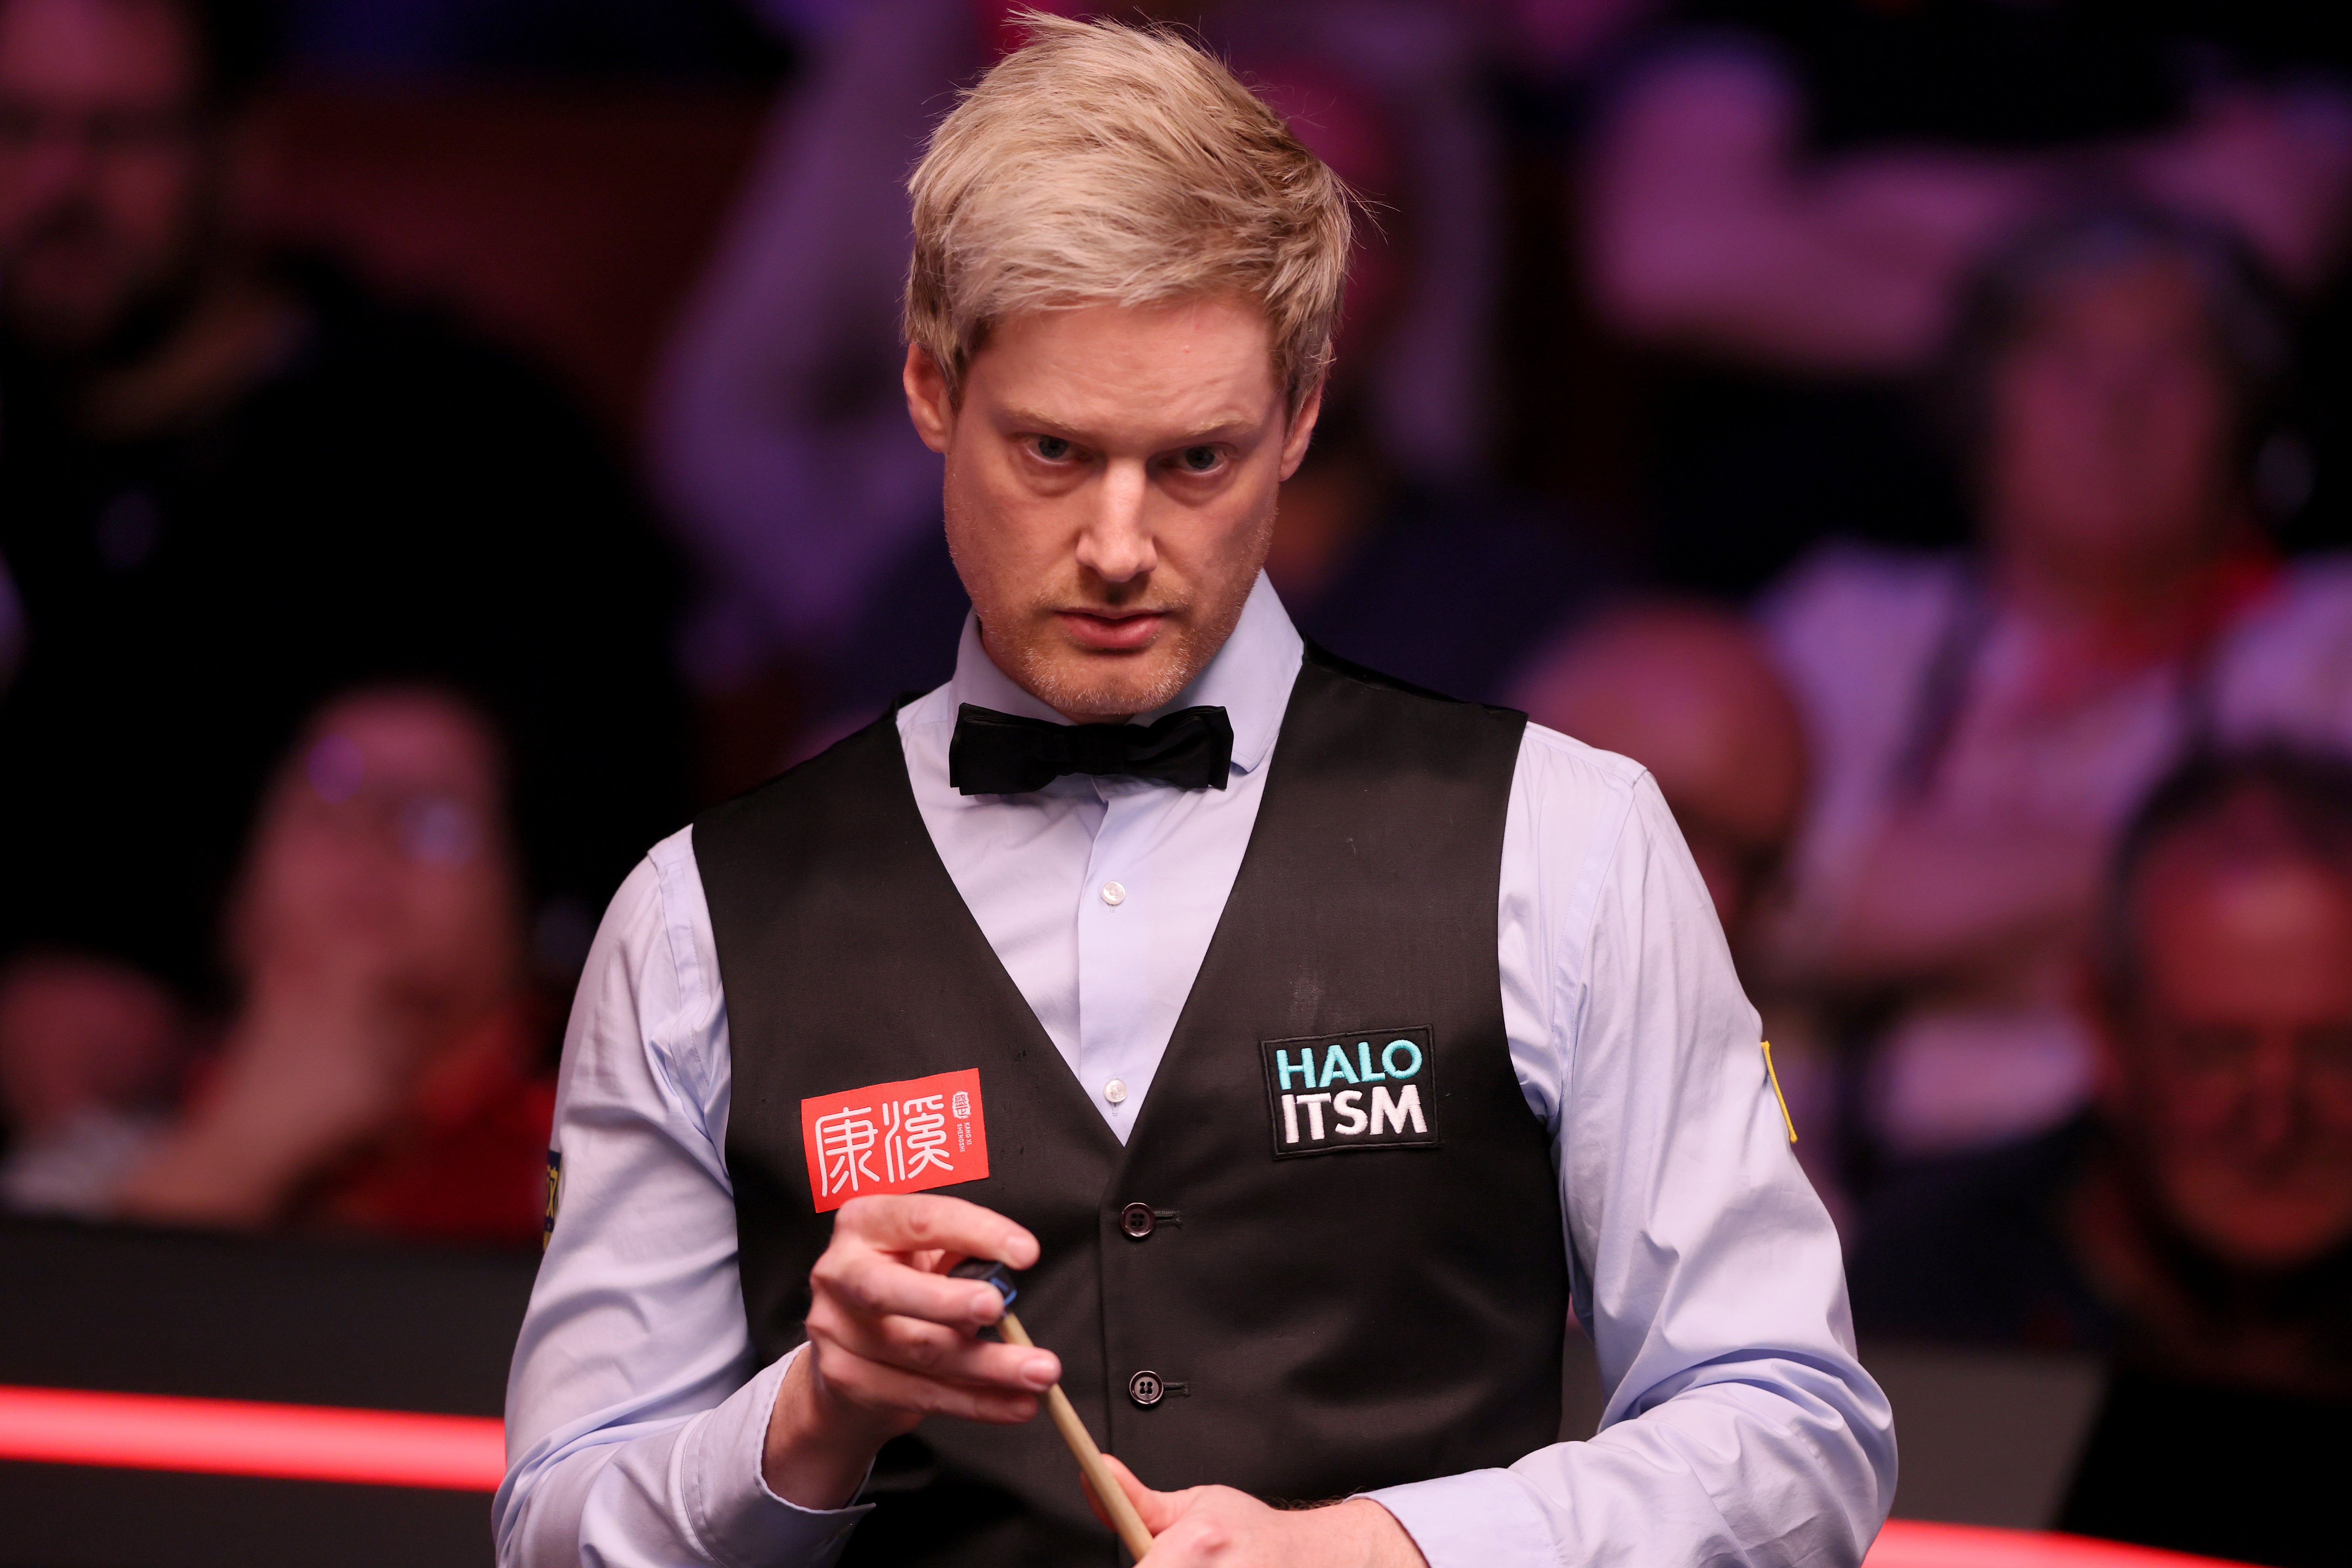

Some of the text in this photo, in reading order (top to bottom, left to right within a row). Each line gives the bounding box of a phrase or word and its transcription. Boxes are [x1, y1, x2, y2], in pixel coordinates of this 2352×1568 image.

[1276, 1040, 1423, 1090] HALO
[1281, 1084, 1428, 1143] ITSM
[957, 1123, 965, 1152] SHENGSHI
[964, 1122, 972, 1145] KANGXI
